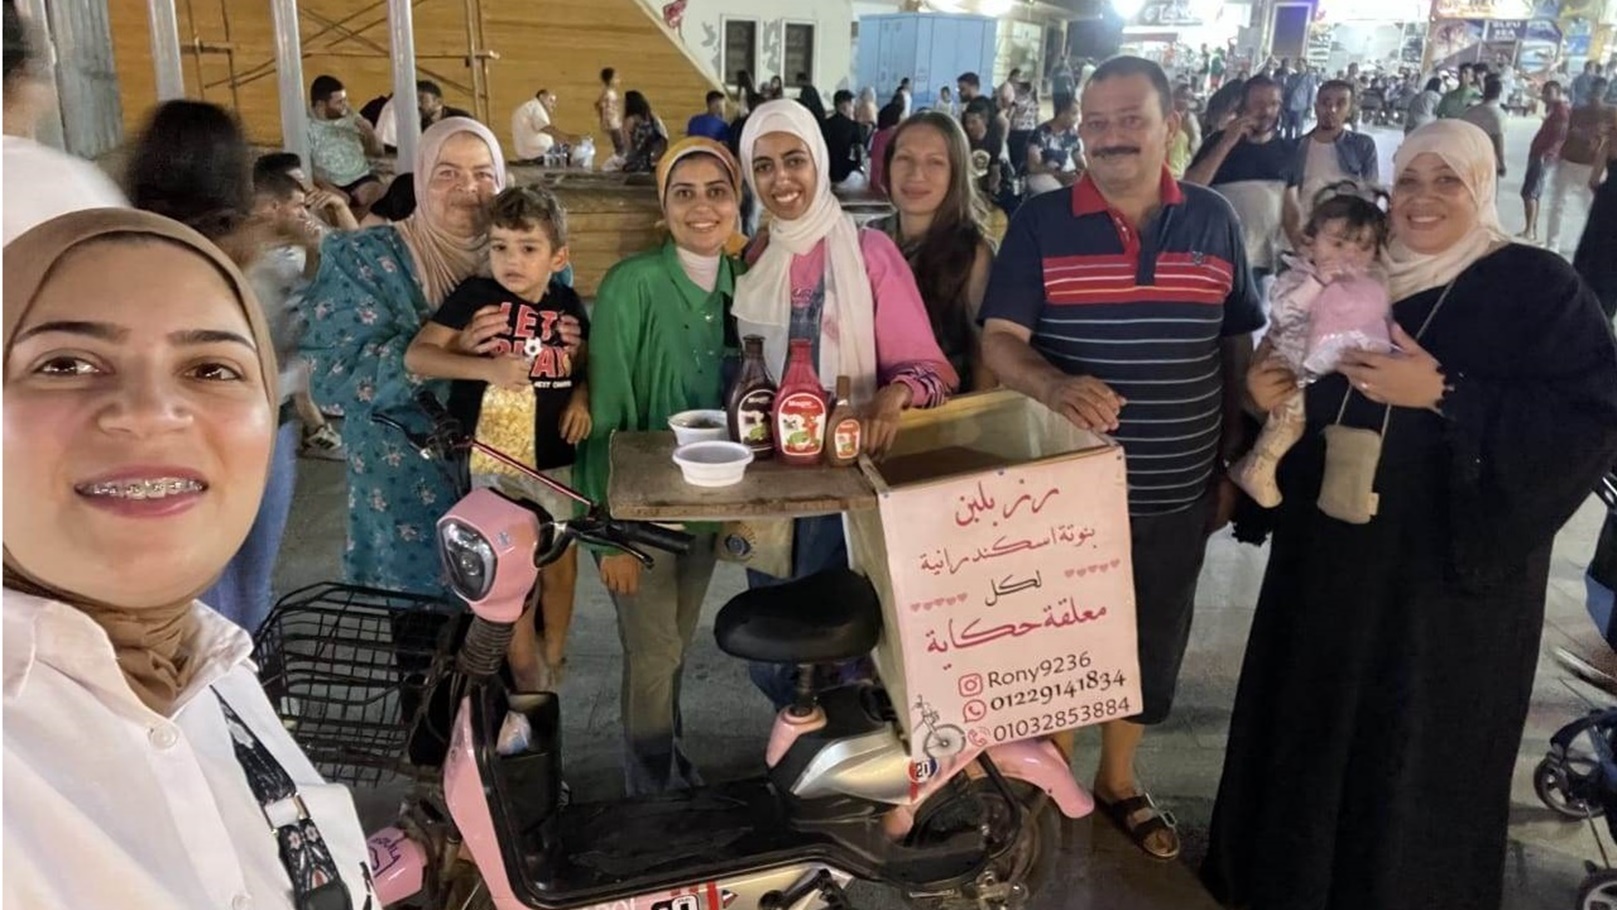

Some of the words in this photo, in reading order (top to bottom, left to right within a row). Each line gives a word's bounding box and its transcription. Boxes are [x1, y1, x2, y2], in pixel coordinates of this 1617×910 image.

[955, 481, 998, 526] بلبن
[1003, 479, 1060, 519] رز
[984, 570, 1042, 607] لكل
[988, 651, 1092, 688] Rony9236
[990, 669, 1127, 711] 01229141834
[993, 696, 1131, 742] 01032853884
